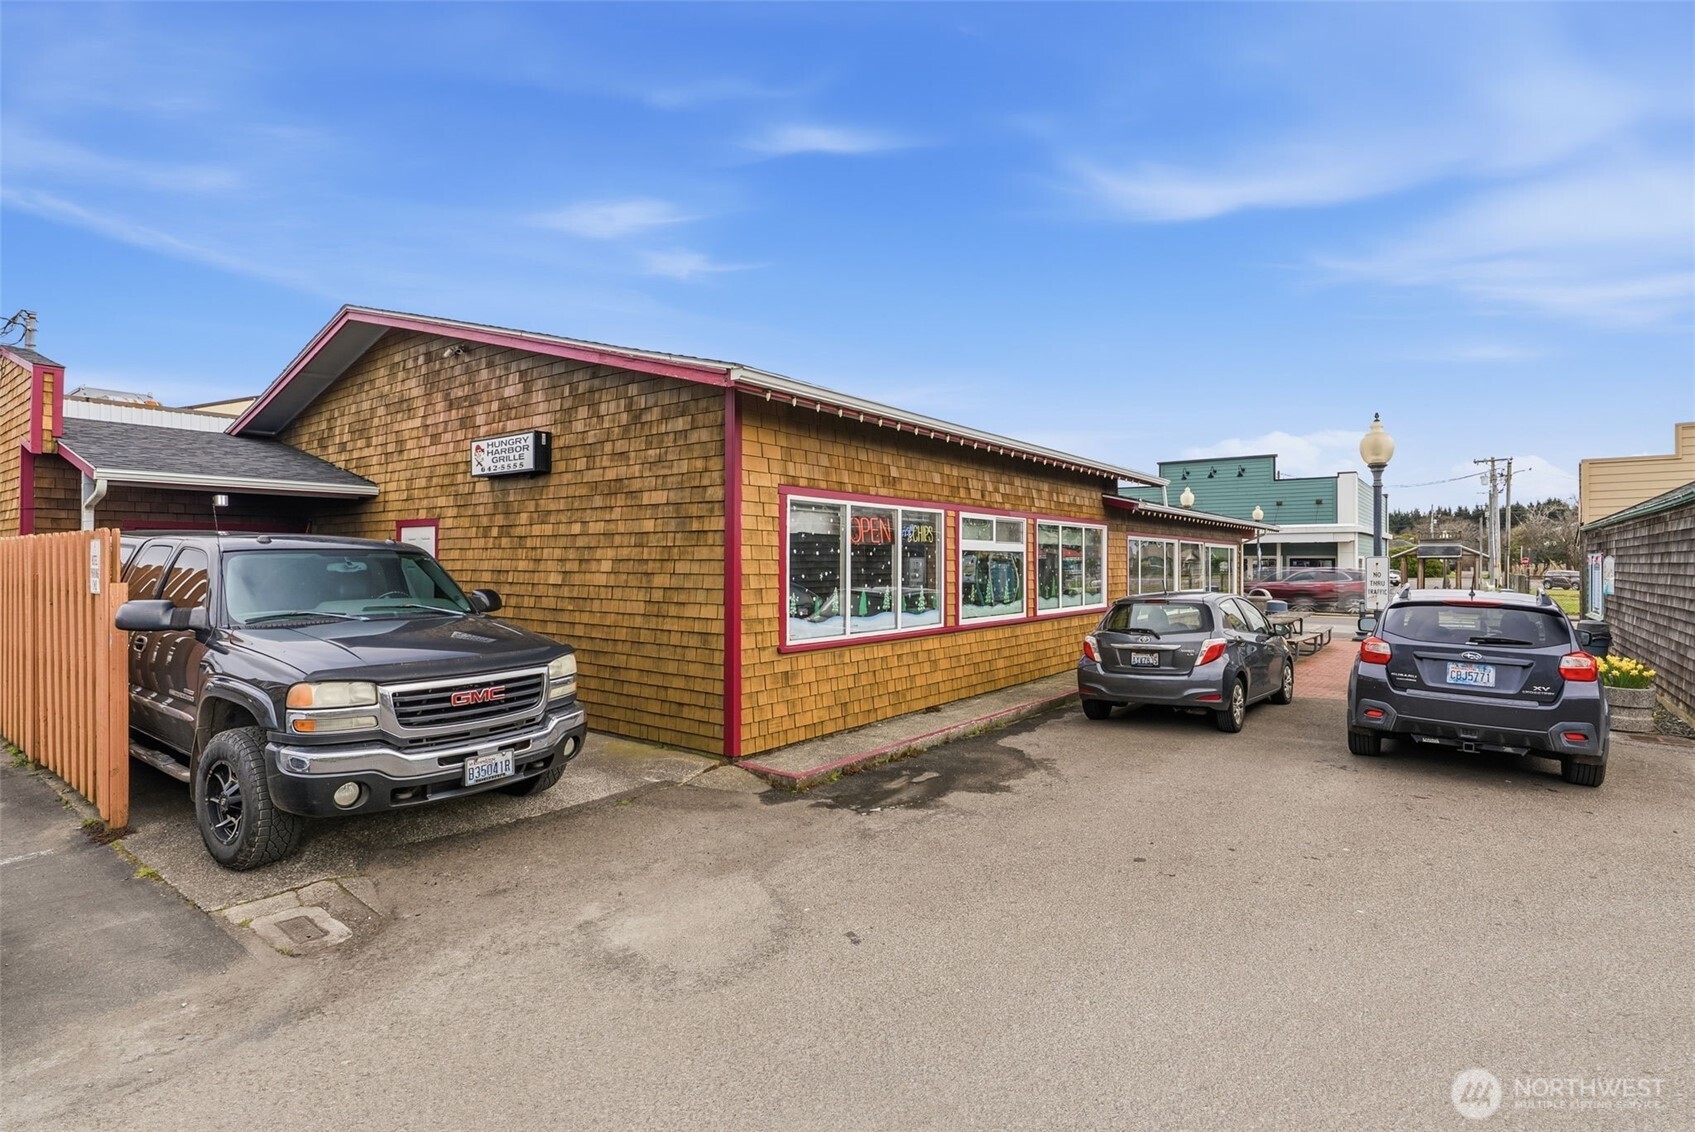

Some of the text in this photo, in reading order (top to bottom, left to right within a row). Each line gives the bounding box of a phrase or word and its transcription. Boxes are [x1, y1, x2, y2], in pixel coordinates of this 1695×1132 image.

[486, 435, 530, 449] HUNGRY
[486, 444, 530, 457] HARBOR
[491, 453, 525, 464] GRILLE
[480, 462, 524, 473] 642-5555
[850, 516, 892, 544] OPEN
[1450, 669, 1490, 682] CBJ5771
[451, 685, 506, 707] GMC
[468, 759, 511, 781] B35041R
